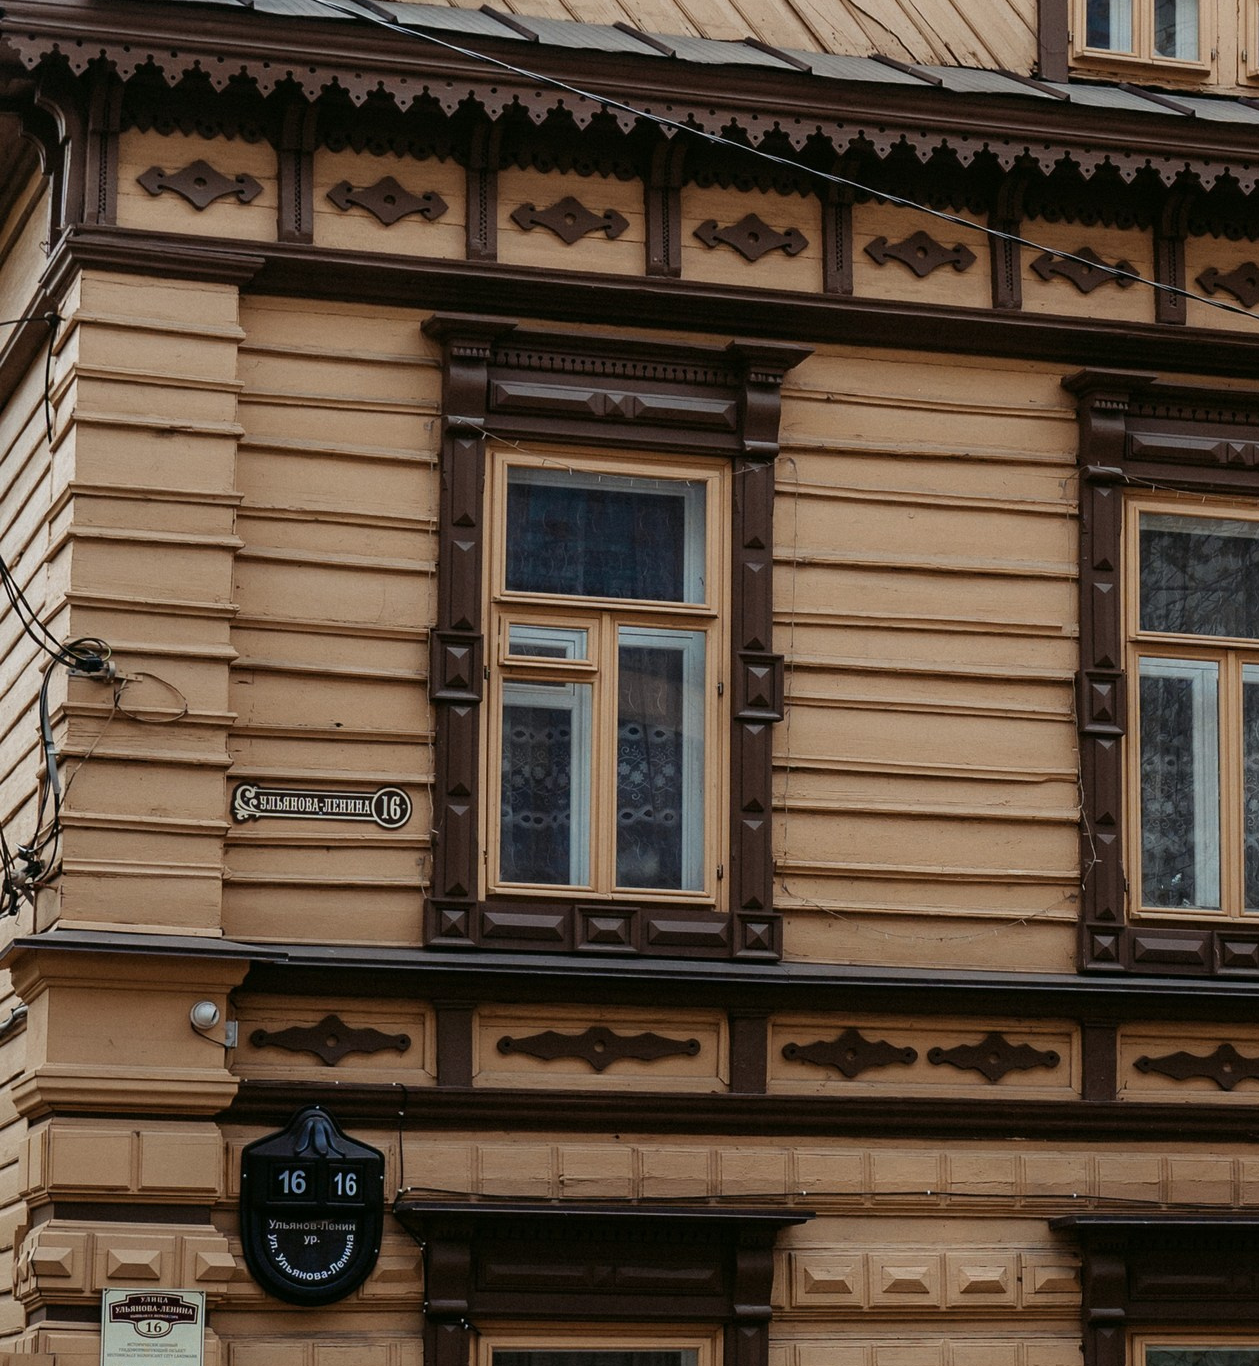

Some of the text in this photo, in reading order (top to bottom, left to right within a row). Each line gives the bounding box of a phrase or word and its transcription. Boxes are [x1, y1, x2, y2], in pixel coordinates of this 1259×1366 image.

[259, 795, 400, 819] УЛЬЯНОВА-ЛЕНИНА 16
[278, 1170, 306, 1194] 16
[334, 1172, 357, 1196] 16
[269, 1219, 356, 1231] Ульянов-Ленин
[304, 1235, 320, 1244] ур.
[267, 1234, 354, 1280] ул. Ульянова-Ленина
[140, 1296, 168, 1304] УЛИЦА
[115, 1305, 193, 1315] УЛЬЯНОВА-ЛЕНИНА
[145, 1322, 162, 1333] 16
